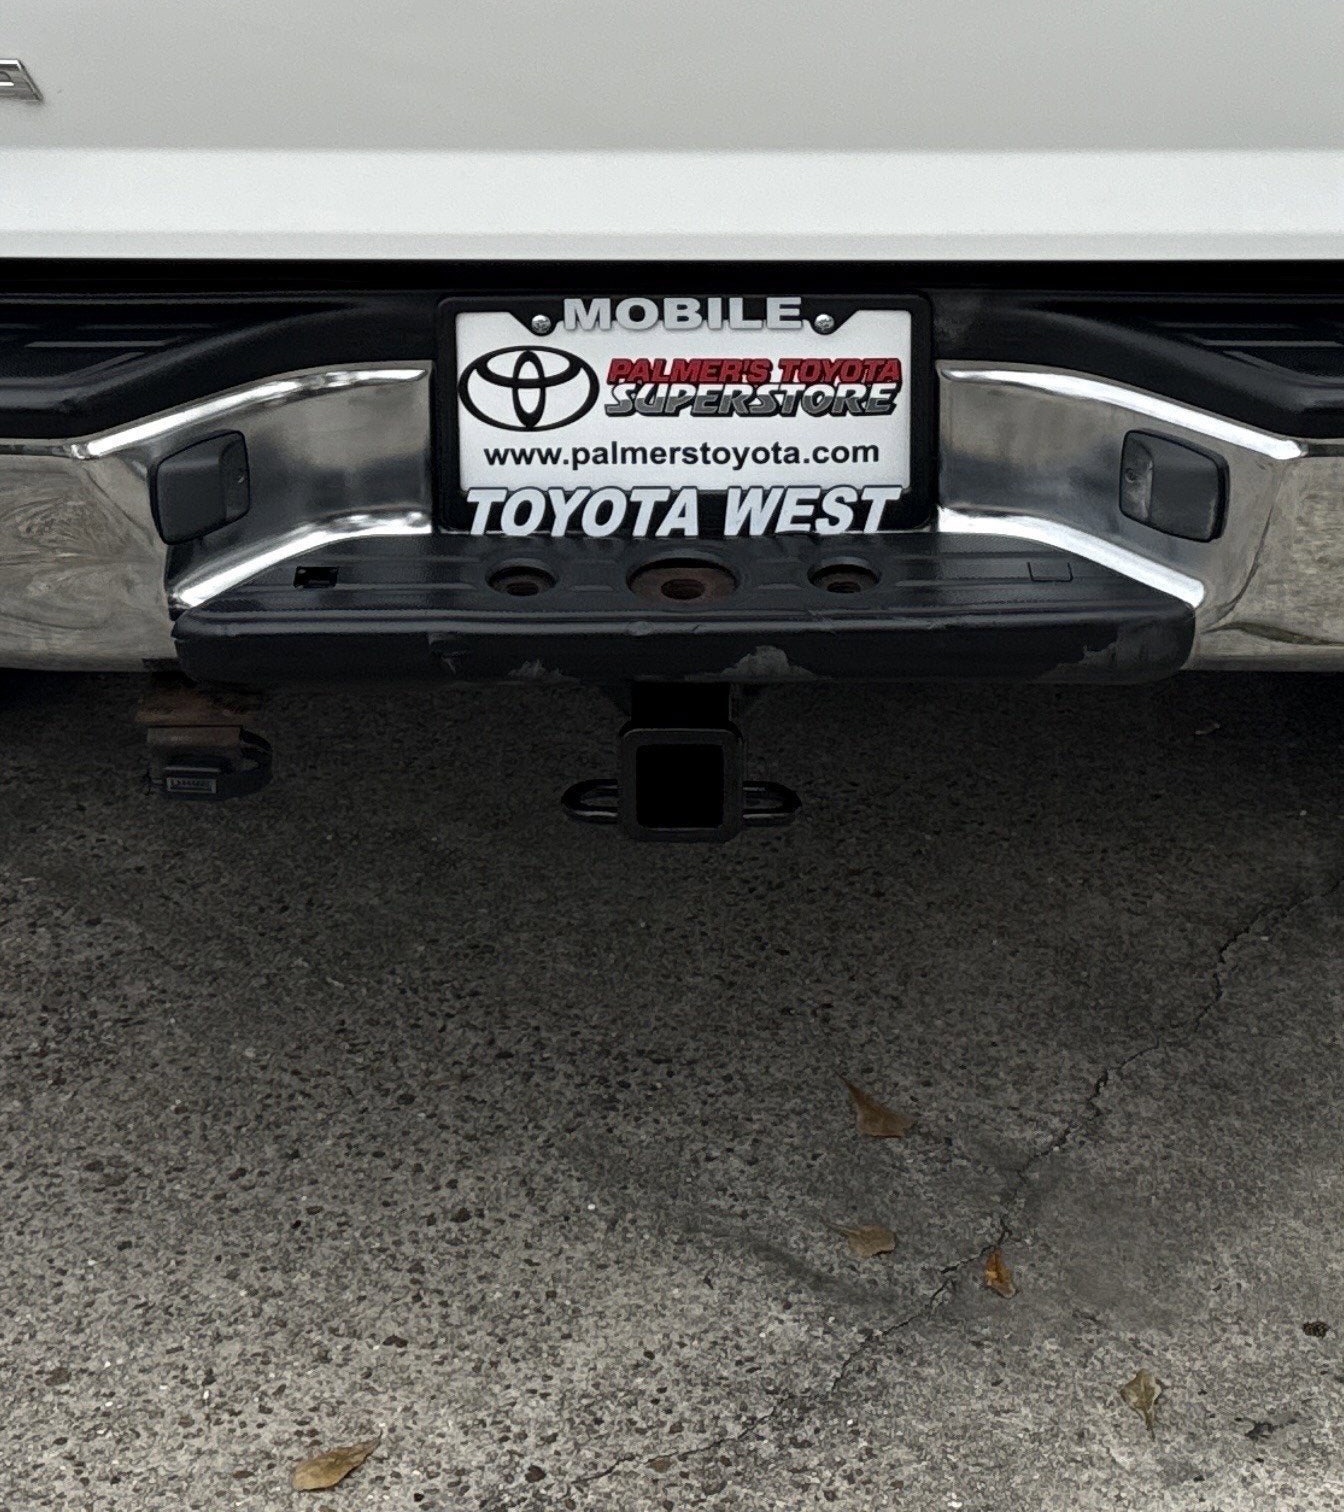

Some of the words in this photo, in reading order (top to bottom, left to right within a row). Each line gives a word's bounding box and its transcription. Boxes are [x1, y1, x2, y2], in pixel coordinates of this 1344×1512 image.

[563, 296, 803, 331] MOBILE
[606, 357, 772, 385] PALMER'S
[778, 357, 903, 385] TOYOTA
[604, 383, 901, 418] SUPERSTORE
[484, 441, 881, 471] www.palmerstoyota.com
[466, 485, 701, 538] TOYOTA
[723, 485, 904, 538] WEST
